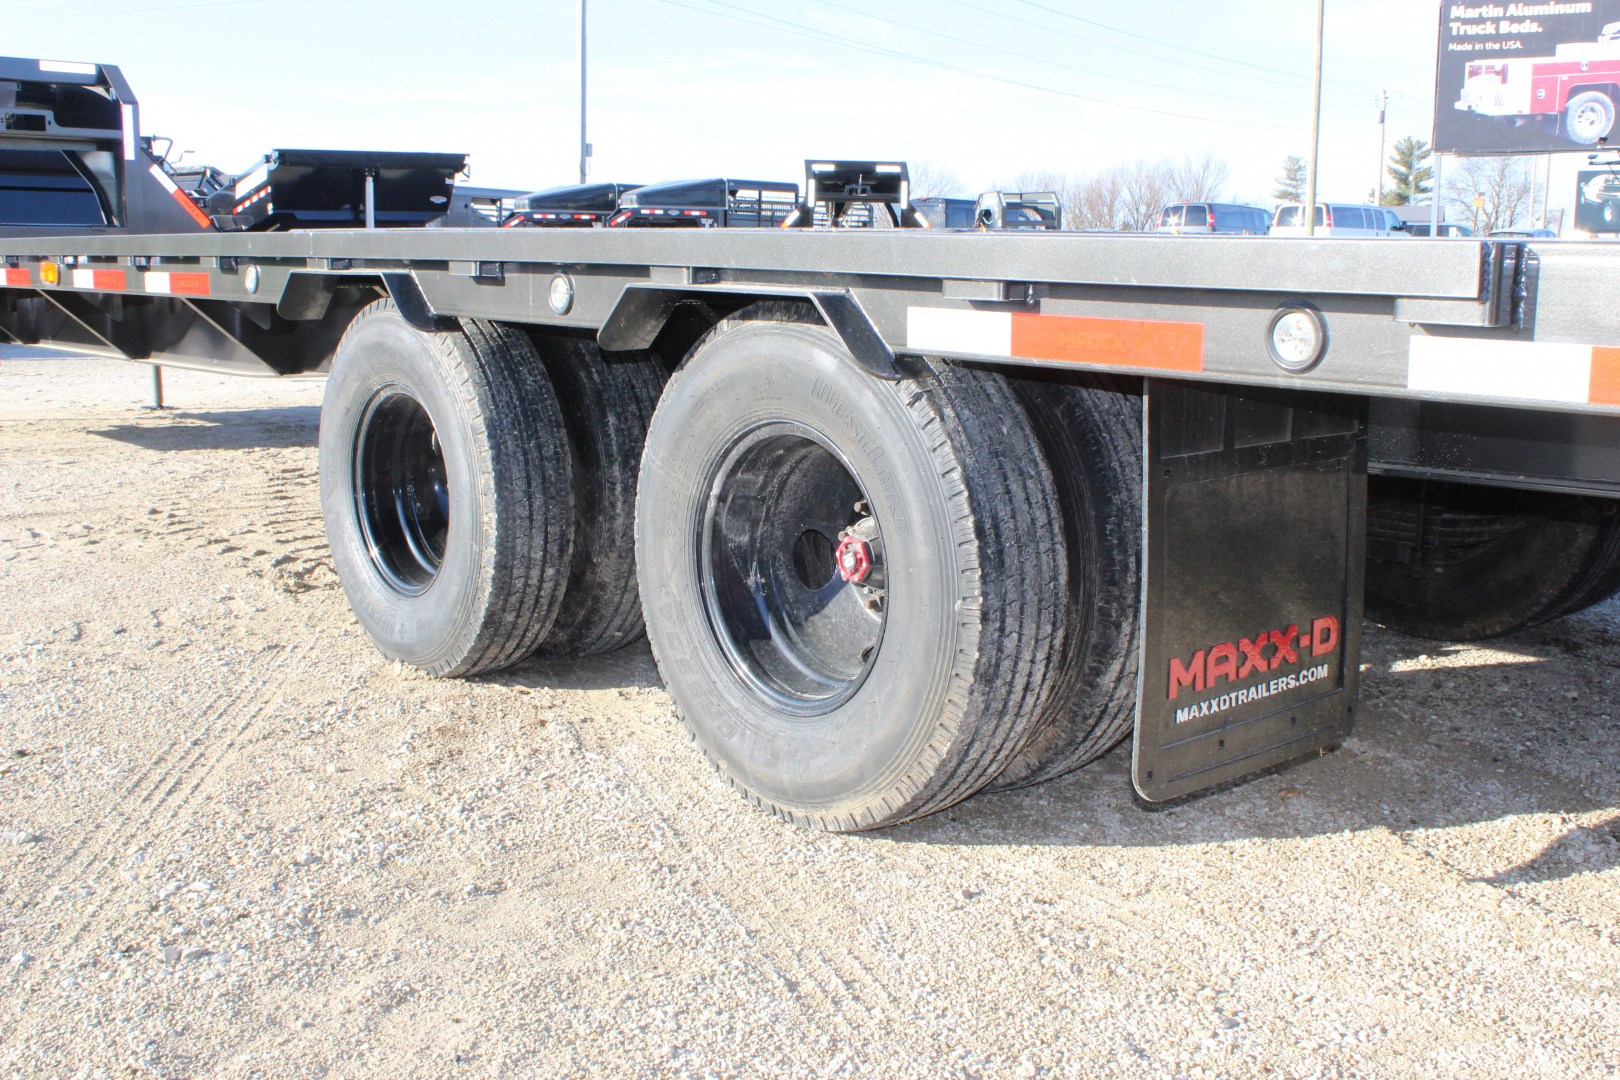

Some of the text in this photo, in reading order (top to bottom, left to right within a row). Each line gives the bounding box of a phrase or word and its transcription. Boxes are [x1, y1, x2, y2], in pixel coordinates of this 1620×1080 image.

[1450, 2, 1592, 19] Martin Aluminum
[1449, 20, 1543, 35] Truck Beds.
[1449, 40, 1523, 51] Made in the USA.
[1167, 615, 1339, 700] MAXX-D
[1175, 663, 1328, 724] MAXXDTRAILERS.COM
